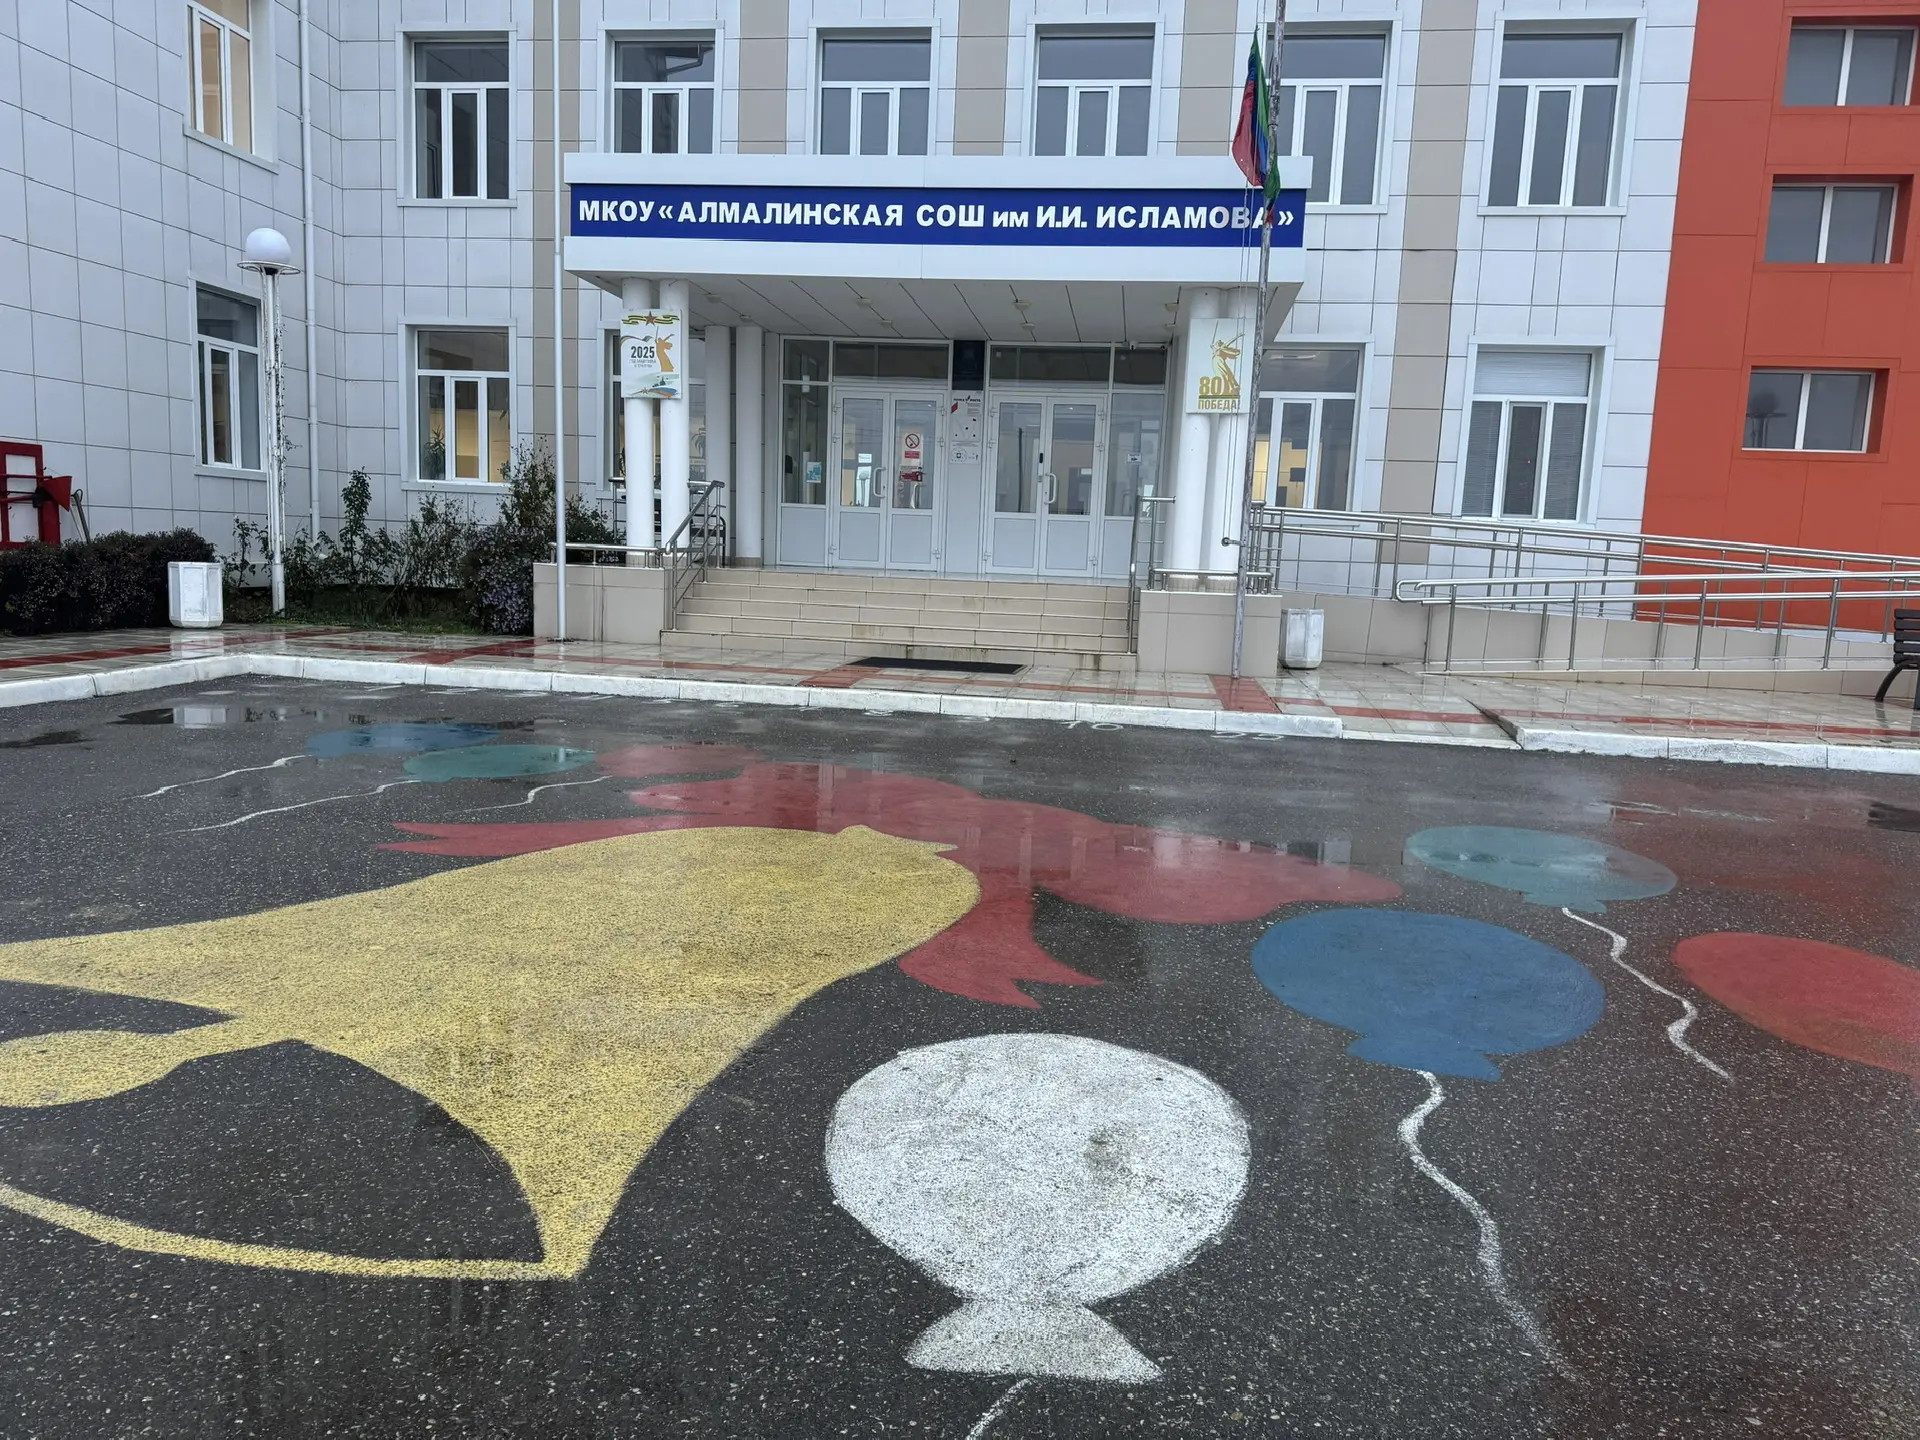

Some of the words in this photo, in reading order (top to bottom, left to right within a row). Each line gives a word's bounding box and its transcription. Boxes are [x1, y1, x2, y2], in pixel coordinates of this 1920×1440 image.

[578, 200, 654, 222] МКОУ
[658, 201, 903, 226] «АЛМАЛИНСКАЯ
[916, 205, 984, 227] СОШ
[992, 212, 1028, 228] им
[1036, 205, 1087, 228] И.И.
[630, 346, 655, 359] 2025
[1199, 376, 1223, 395] 80
